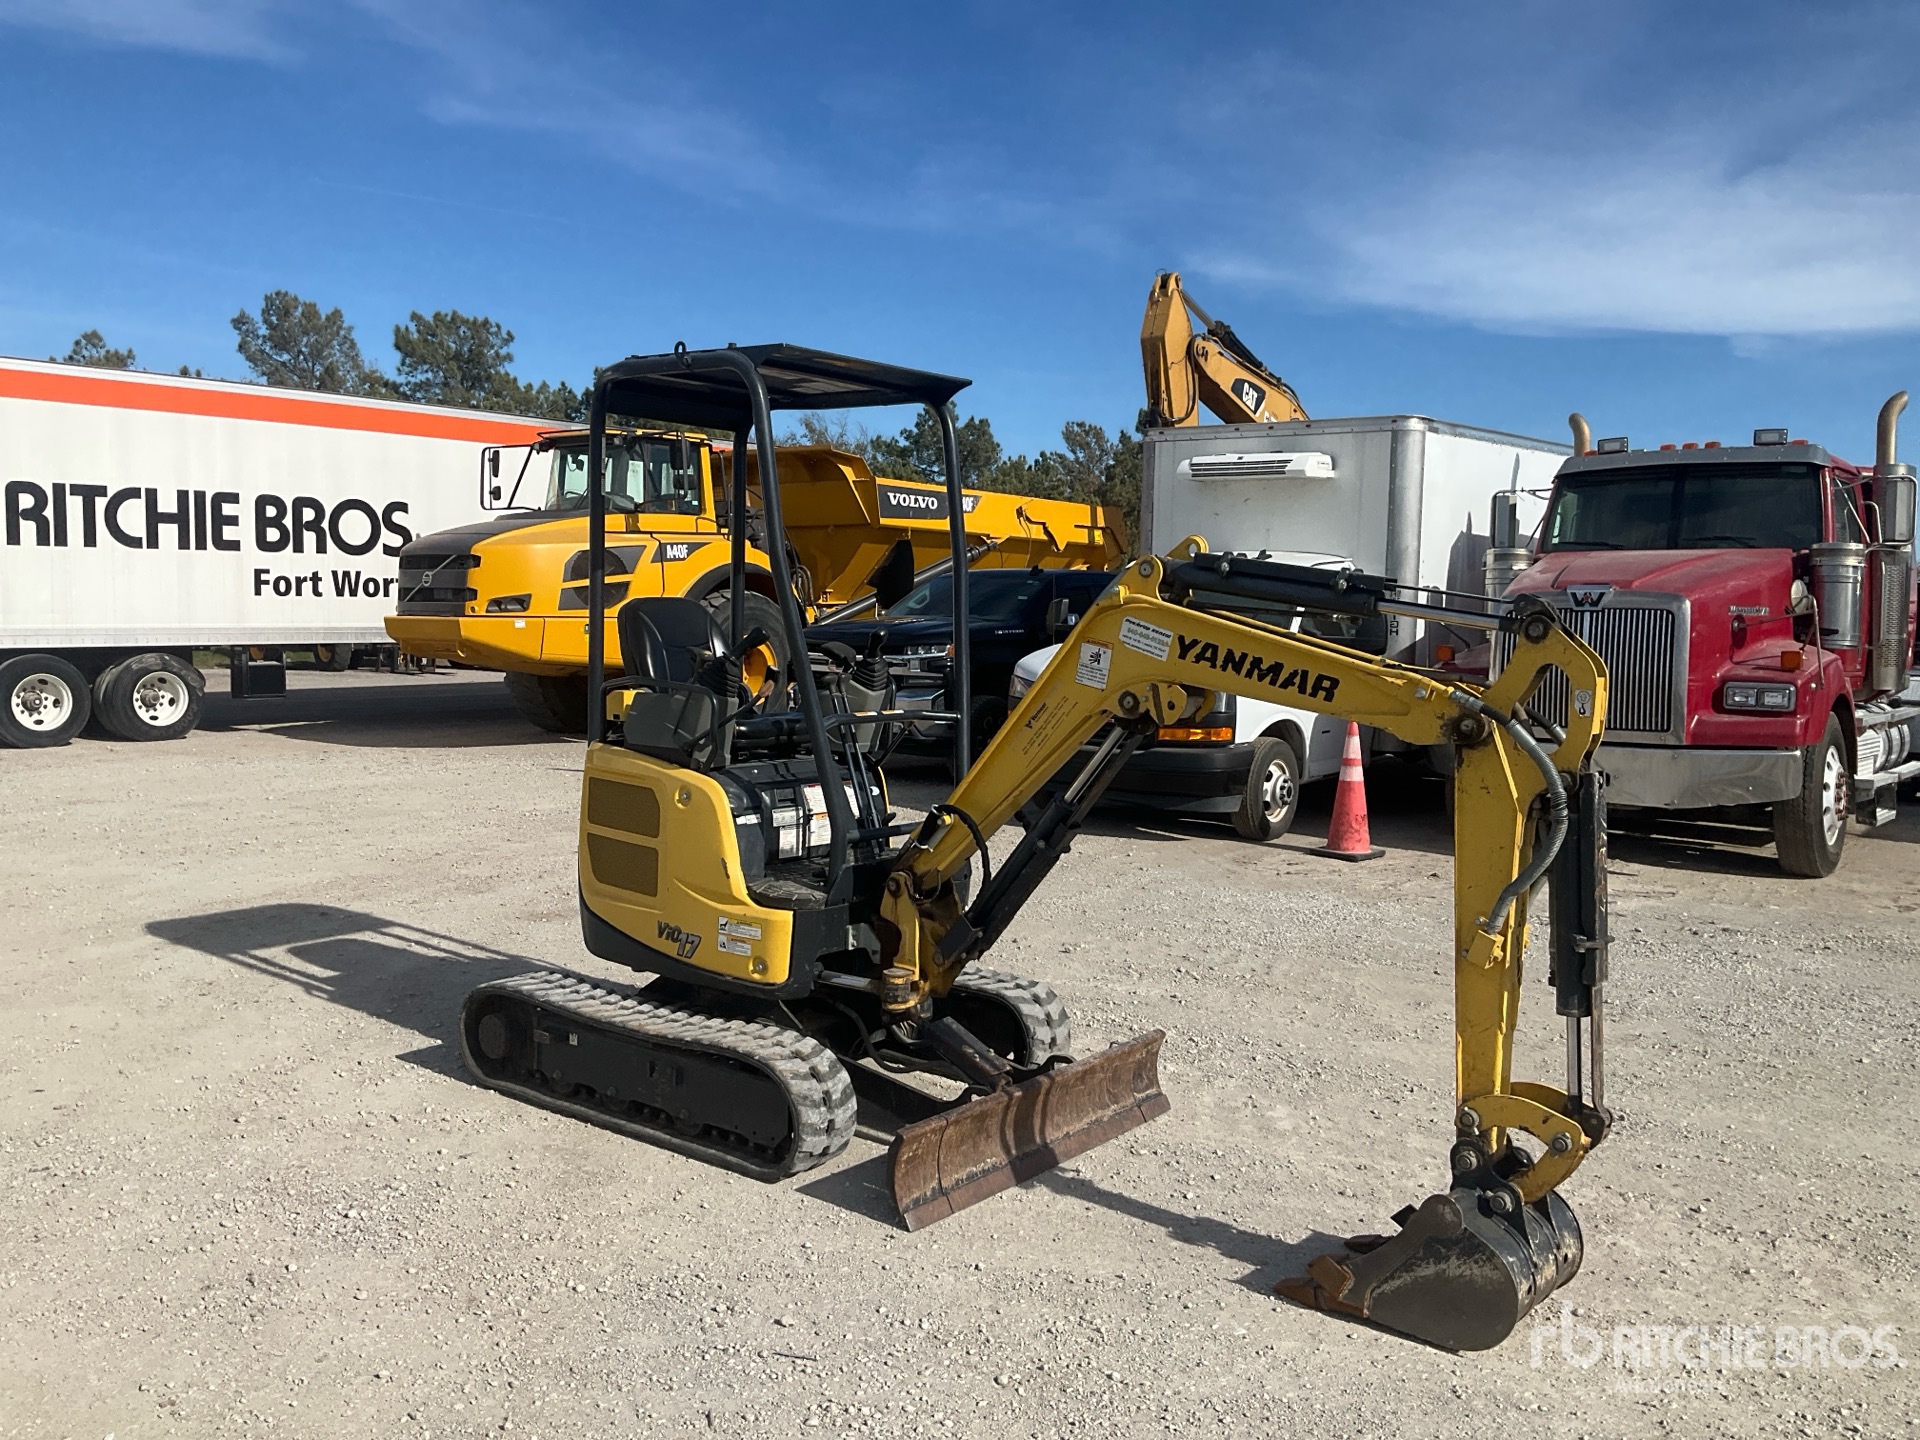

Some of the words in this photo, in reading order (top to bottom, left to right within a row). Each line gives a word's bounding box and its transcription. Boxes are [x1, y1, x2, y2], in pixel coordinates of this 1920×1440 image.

[1242, 382, 1258, 411] CAT
[887, 492, 938, 510] VOLVO
[5, 480, 241, 551] RITCHIE
[254, 493, 413, 558] BROS
[666, 544, 688, 559] A40F
[254, 568, 323, 597] Fort
[331, 569, 399, 598] Wor
[1177, 634, 1341, 703] YANMAR
